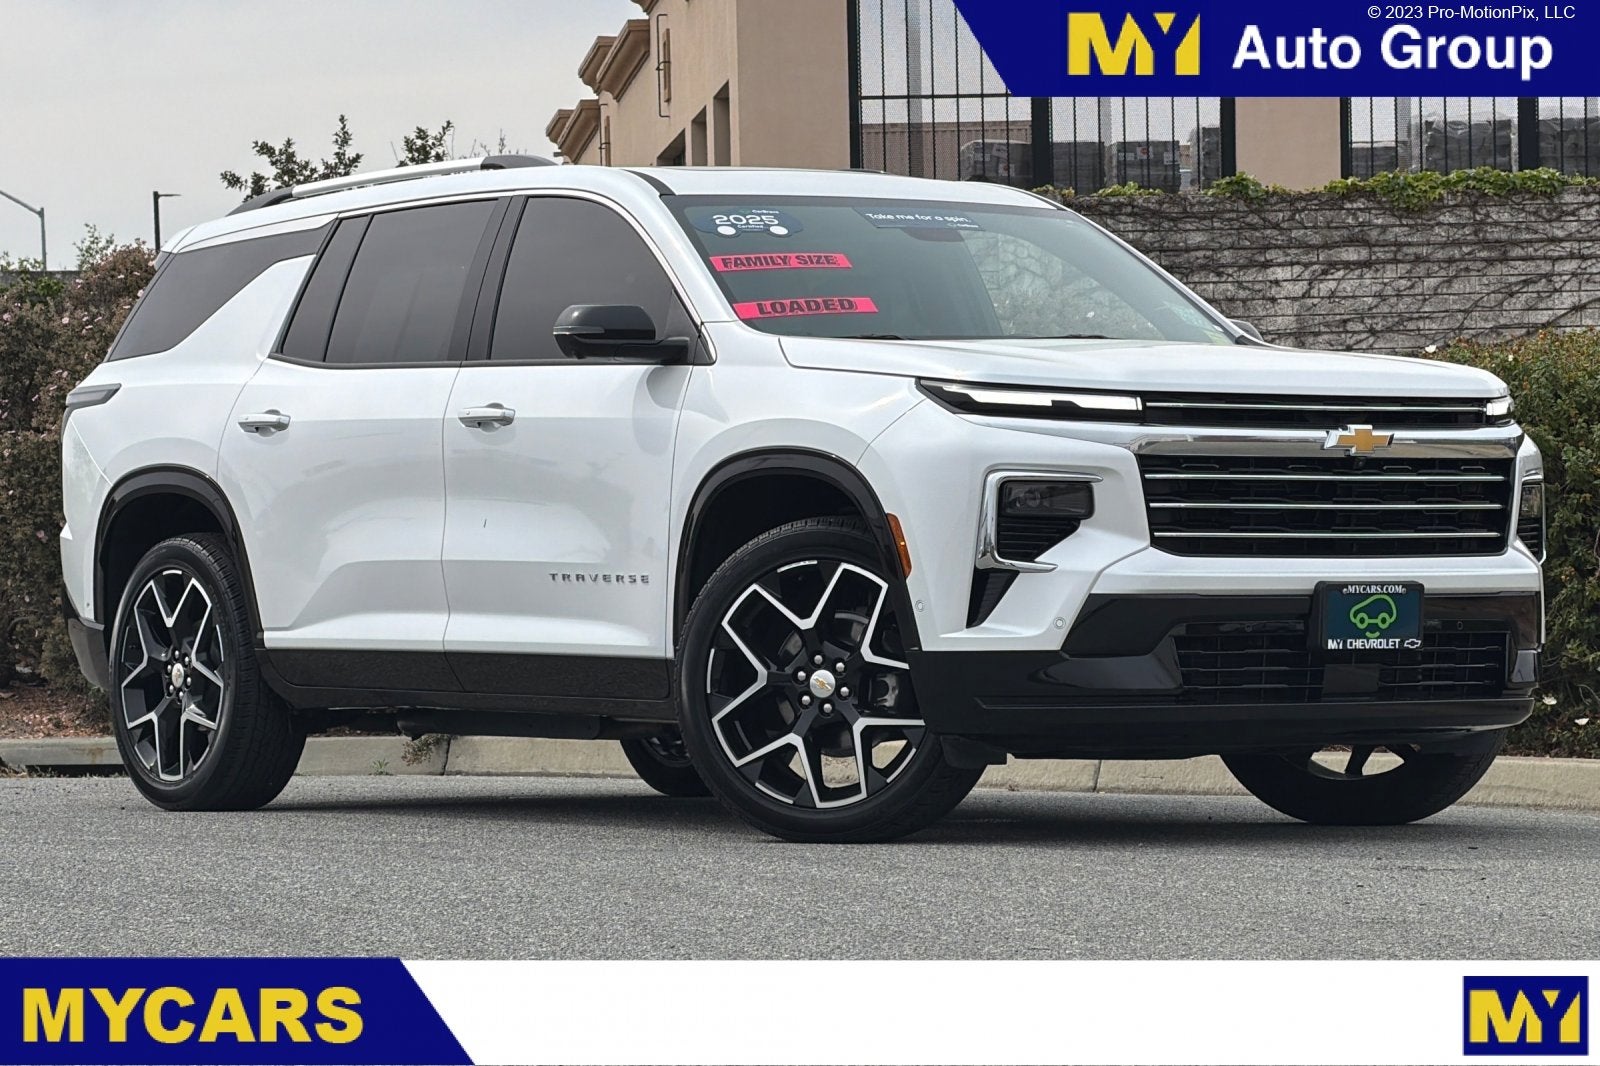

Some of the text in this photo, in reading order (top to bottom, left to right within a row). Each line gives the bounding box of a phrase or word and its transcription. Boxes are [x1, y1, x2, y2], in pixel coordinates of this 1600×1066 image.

[713, 214, 779, 225] 2025
[721, 254, 838, 269] FAMILY SIZE
[757, 298, 857, 315] LOADED
[549, 573, 650, 584] TRAVERSE
[1327, 639, 1401, 650] MY CHEVROLET
